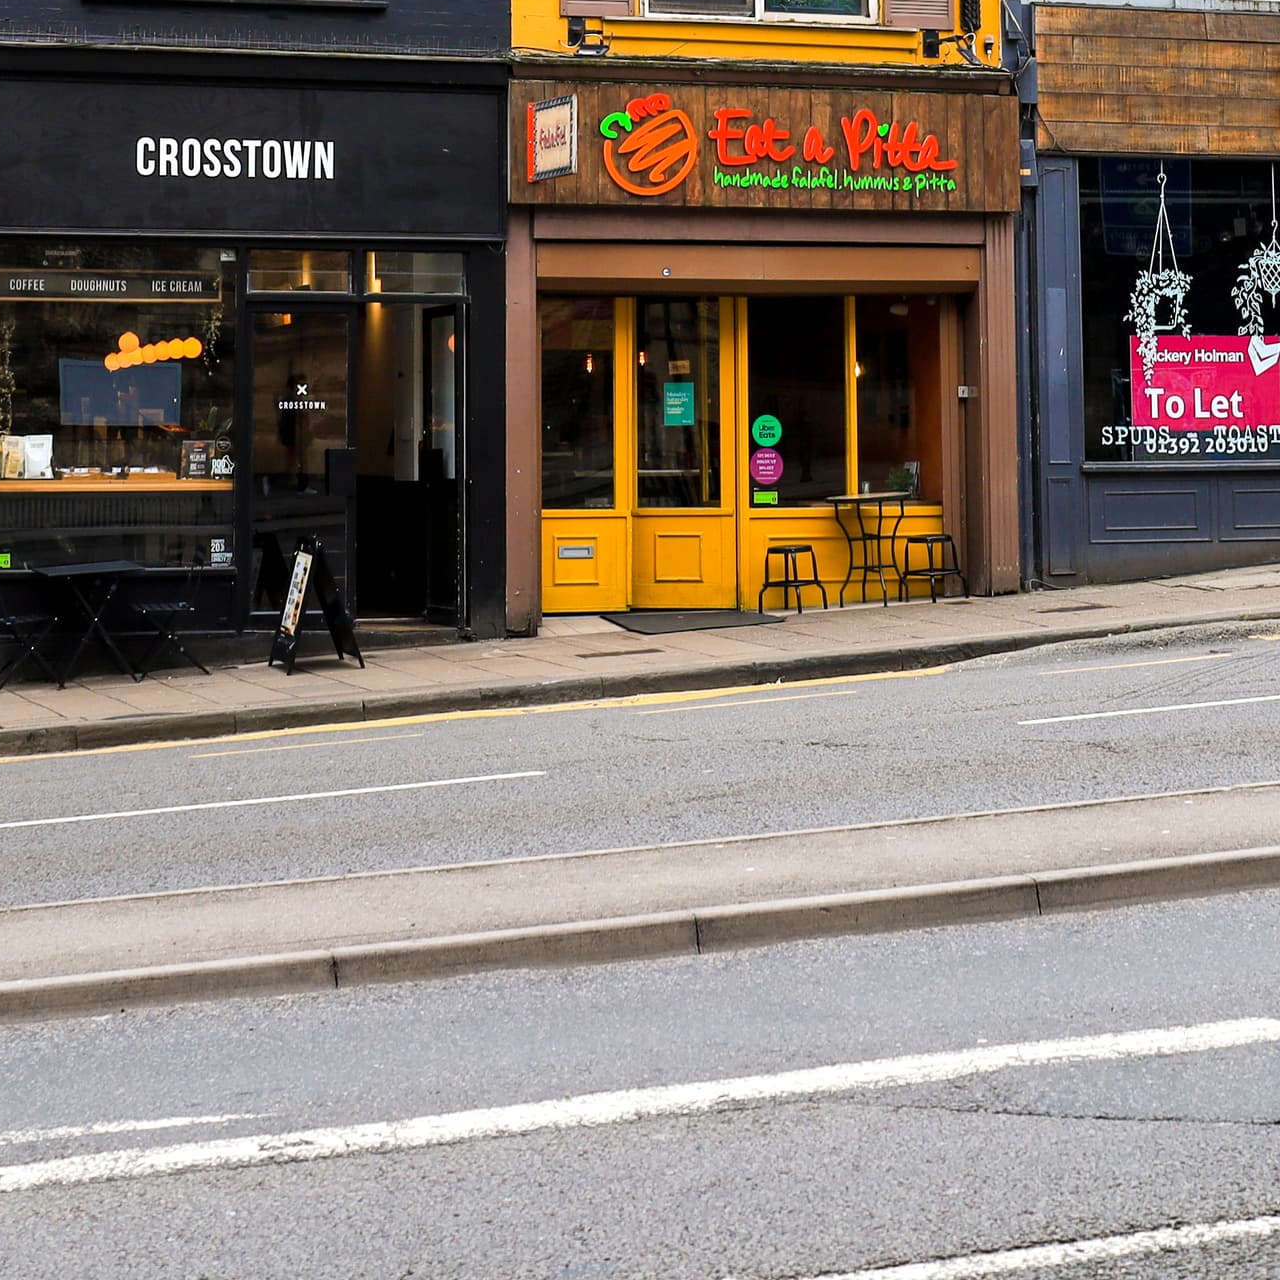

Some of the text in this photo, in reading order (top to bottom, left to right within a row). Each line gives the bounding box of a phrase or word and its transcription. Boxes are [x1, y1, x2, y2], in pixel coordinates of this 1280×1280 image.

[708, 108, 958, 171] Eat a Pitta
[136, 136, 334, 179] CROSSTOWN
[713, 166, 788, 189] handmade
[843, 169, 900, 191] hummus
[902, 175, 913, 191] &
[915, 172, 956, 197] pitta
[9, 278, 202, 293] COFFEE DOUGHNUTS ICE CREAM
[1148, 348, 1245, 365] ickery Holman
[278, 401, 326, 410] CROSSTOWN
[1144, 387, 1245, 419] To Let
[1101, 425, 1171, 446] SPUDS
[1145, 437, 1269, 455] 01392 203010
